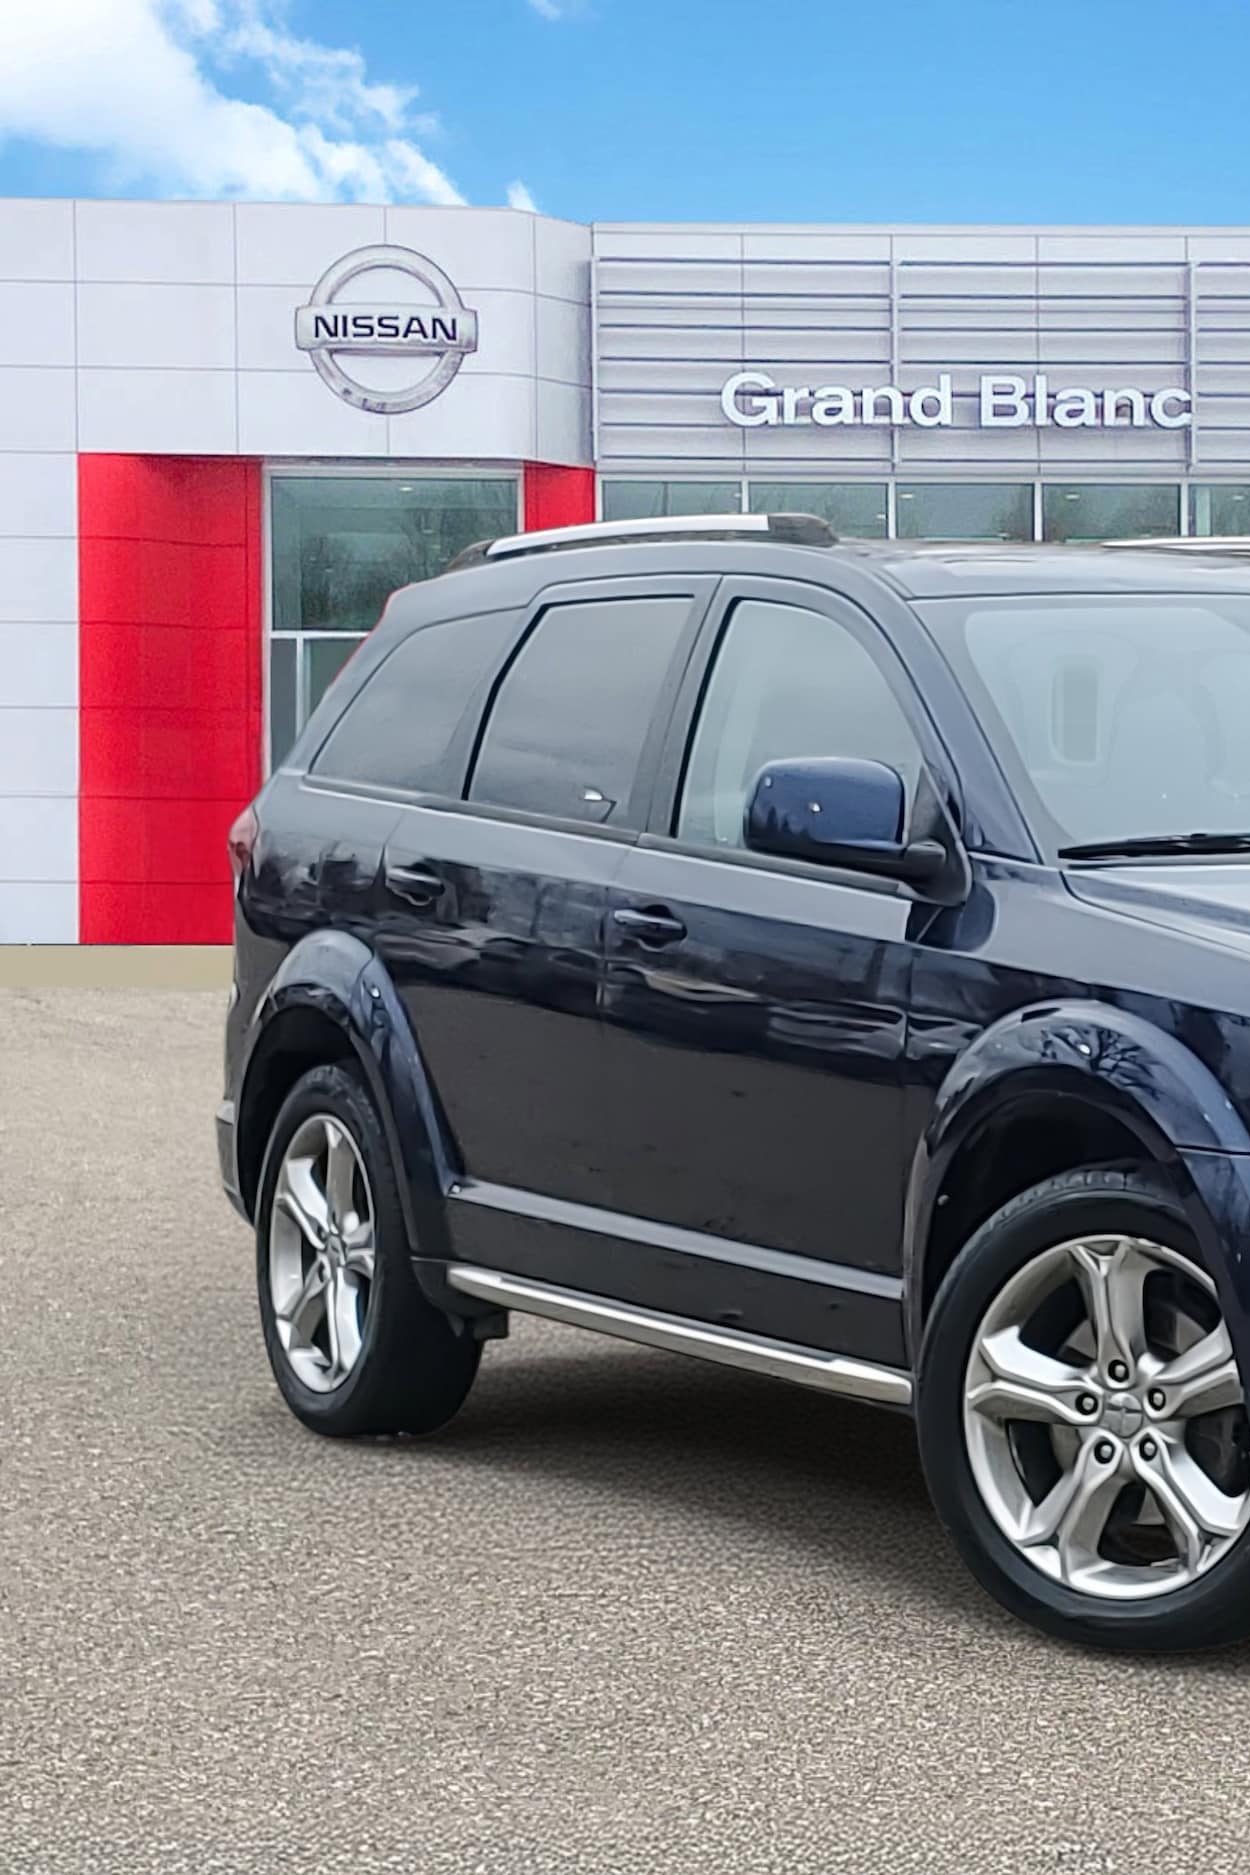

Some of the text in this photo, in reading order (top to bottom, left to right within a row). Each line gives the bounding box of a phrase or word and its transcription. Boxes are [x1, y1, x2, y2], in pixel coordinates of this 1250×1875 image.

[314, 314, 457, 341] NISSAN
[720, 371, 1194, 428] Grand Blanc
